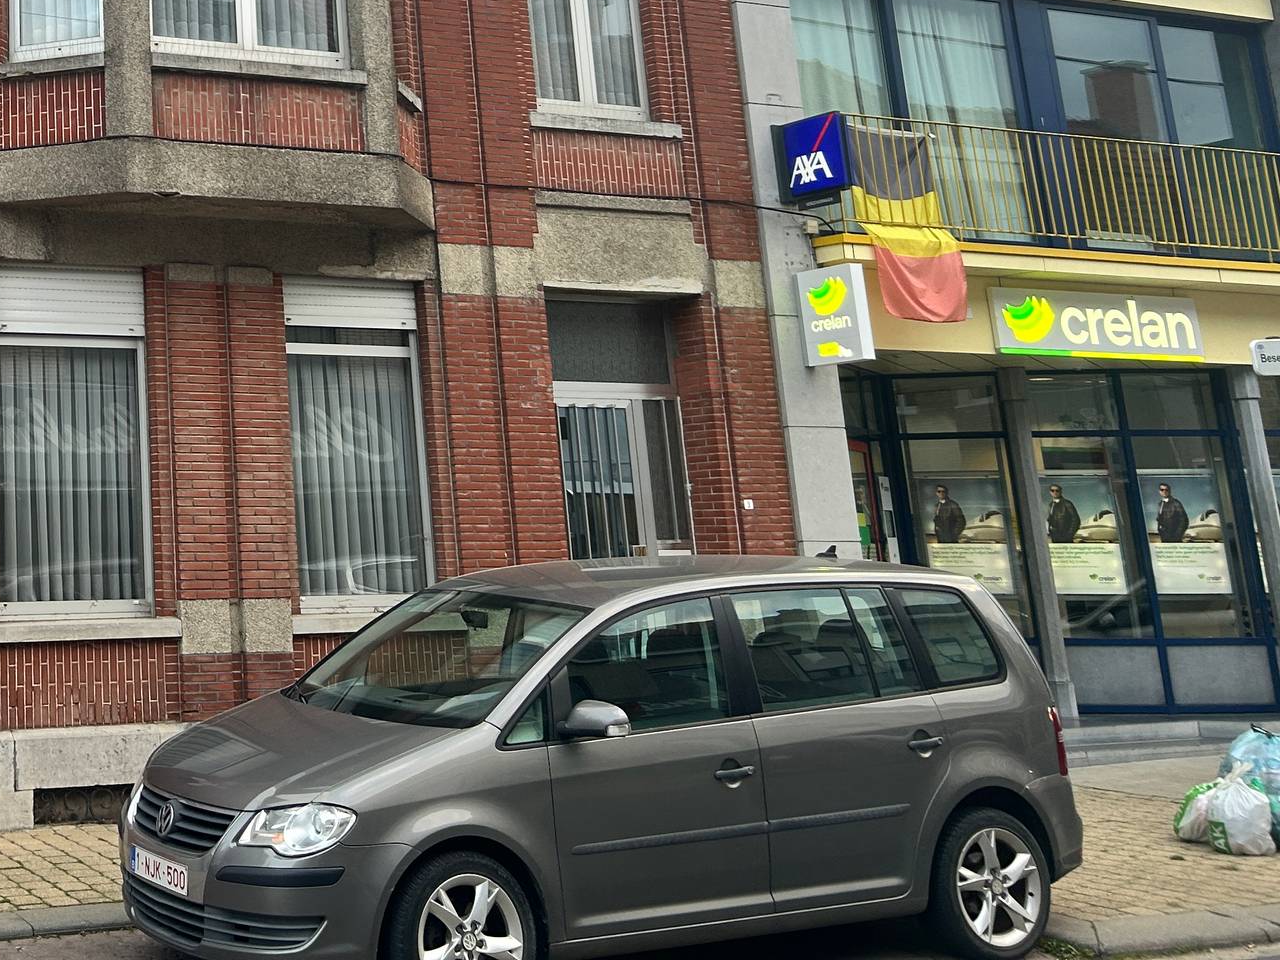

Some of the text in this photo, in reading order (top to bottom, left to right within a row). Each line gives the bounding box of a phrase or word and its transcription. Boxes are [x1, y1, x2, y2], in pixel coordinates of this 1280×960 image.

[790, 151, 833, 188] AXA
[811, 315, 852, 333] crelan
[1061, 299, 1198, 350] crelan
